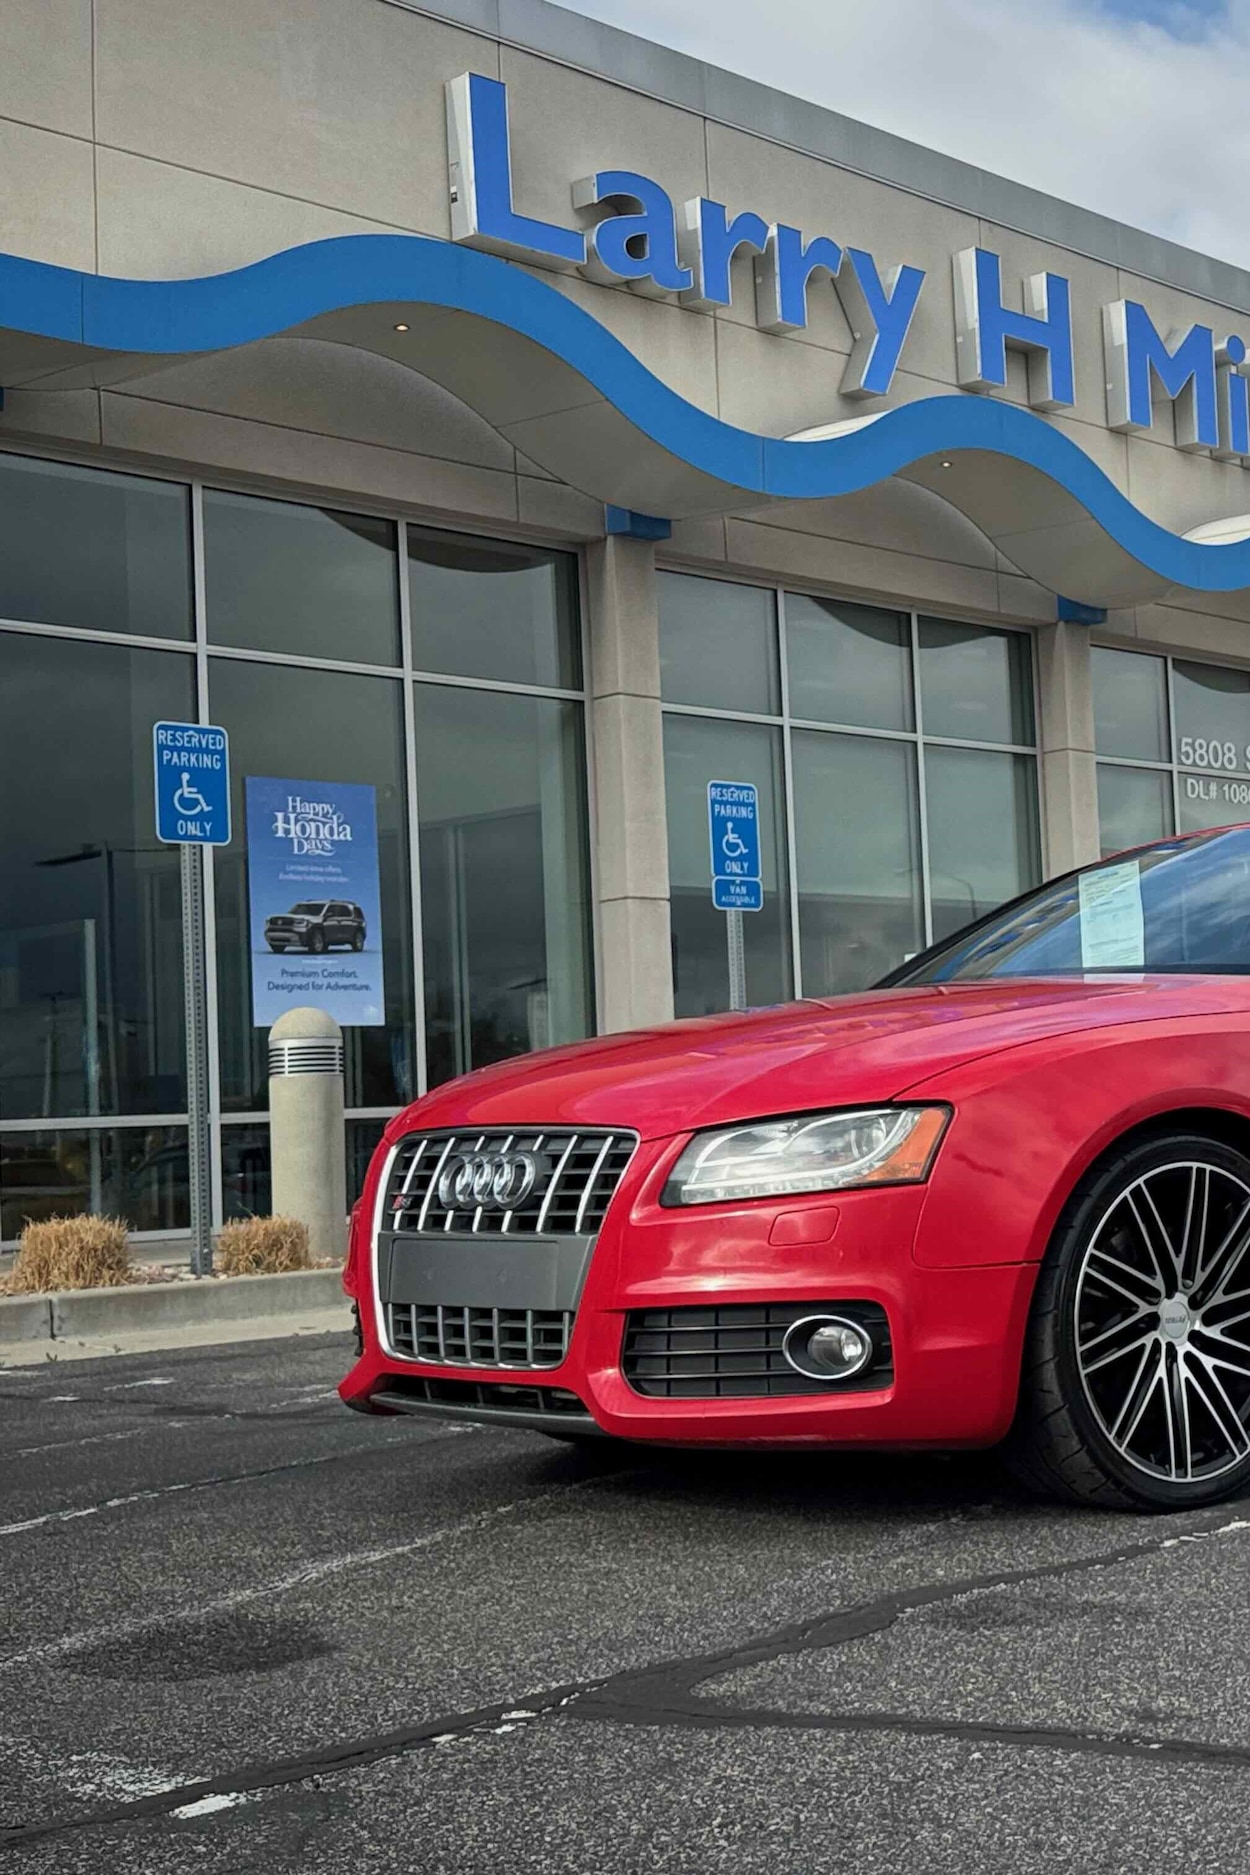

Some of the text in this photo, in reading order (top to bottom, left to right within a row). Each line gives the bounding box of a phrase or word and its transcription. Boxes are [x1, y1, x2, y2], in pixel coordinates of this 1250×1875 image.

[466, 71, 926, 396] Larry
[974, 246, 1075, 408] H
[157, 729, 224, 750] RESERVED
[162, 750, 221, 770] PARKING
[1180, 736, 1237, 770] 5808
[710, 787, 755, 803] RESERVED
[1186, 778, 1217, 800] DL#
[287, 795, 336, 820] Happy
[714, 804, 754, 819] PARKING
[176, 819, 213, 837] ONLY
[272, 811, 353, 841] Honda
[724, 860, 749, 874] ONLY
[729, 884, 748, 895] VAN
[280, 968, 359, 979] Premium Comfort.
[267, 981, 373, 993] Designed for Adventure.
